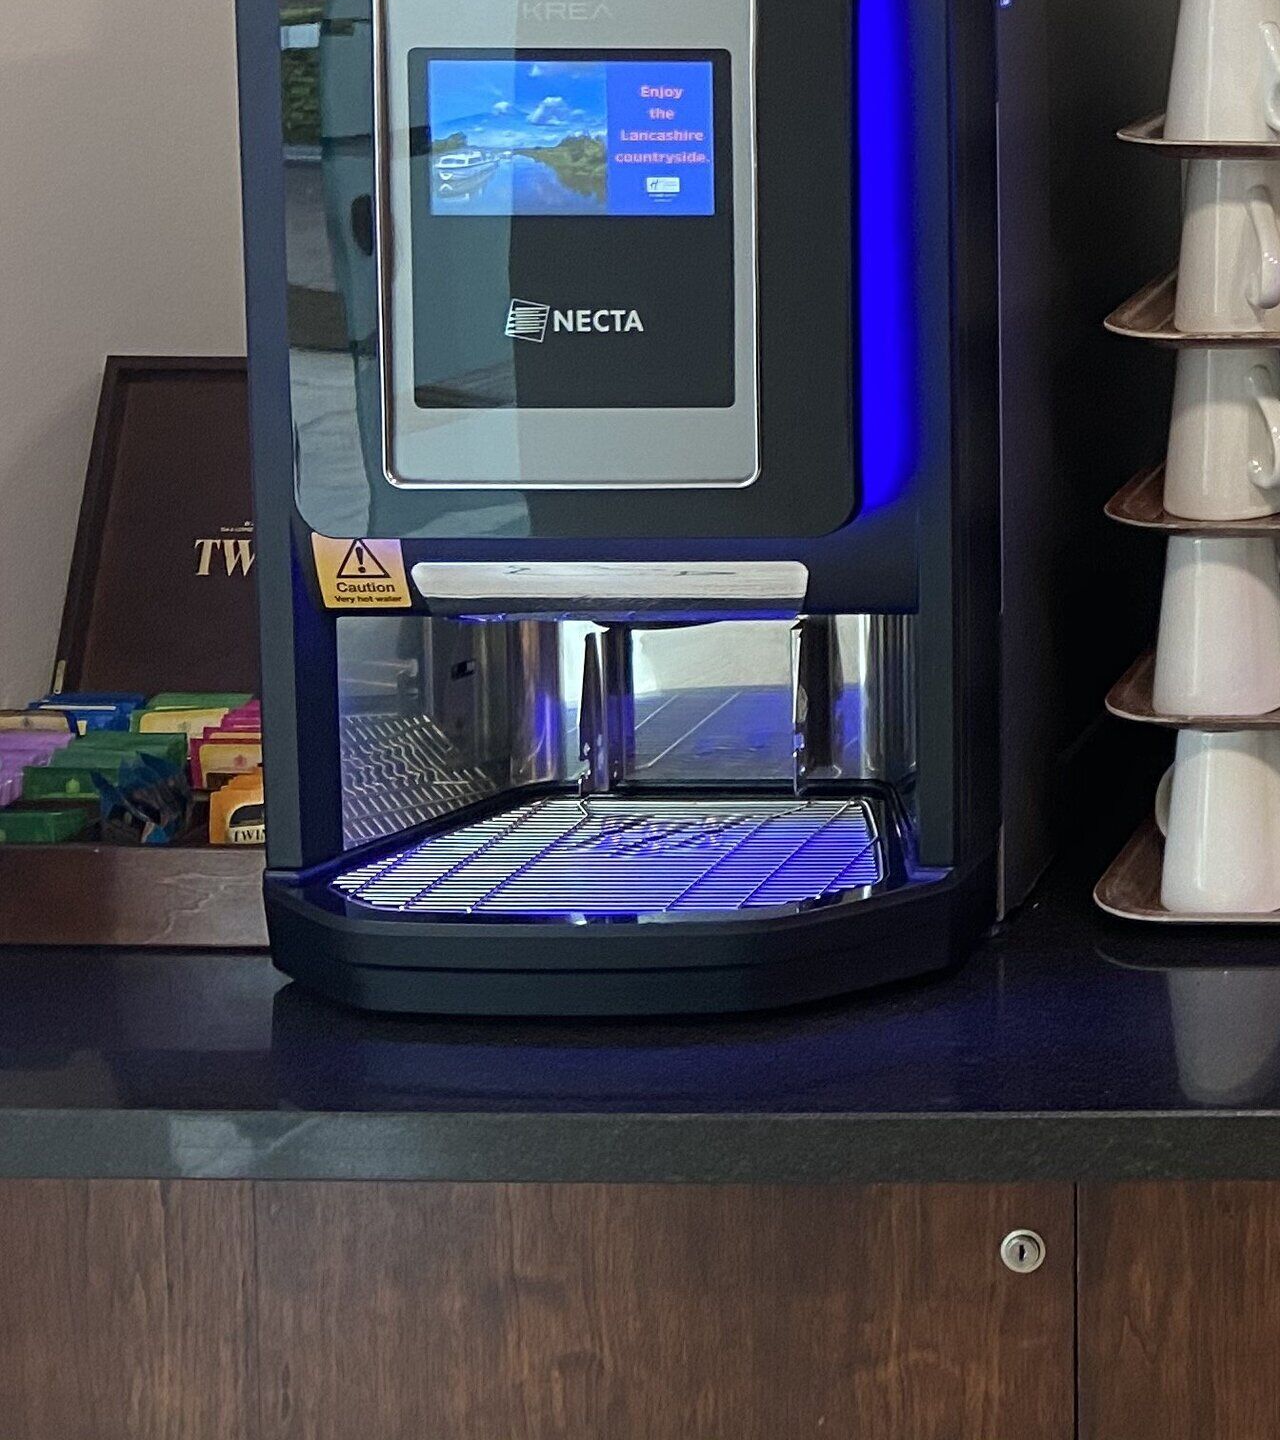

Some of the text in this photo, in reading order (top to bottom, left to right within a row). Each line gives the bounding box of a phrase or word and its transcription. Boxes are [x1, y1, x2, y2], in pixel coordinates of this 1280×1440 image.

[640, 85, 684, 99] Enjoy
[649, 107, 675, 120] the
[620, 129, 704, 142] Lancashire
[553, 309, 644, 333] NECTA
[336, 581, 396, 594] Caution
[334, 595, 356, 604] Very
[357, 595, 374, 603] hot
